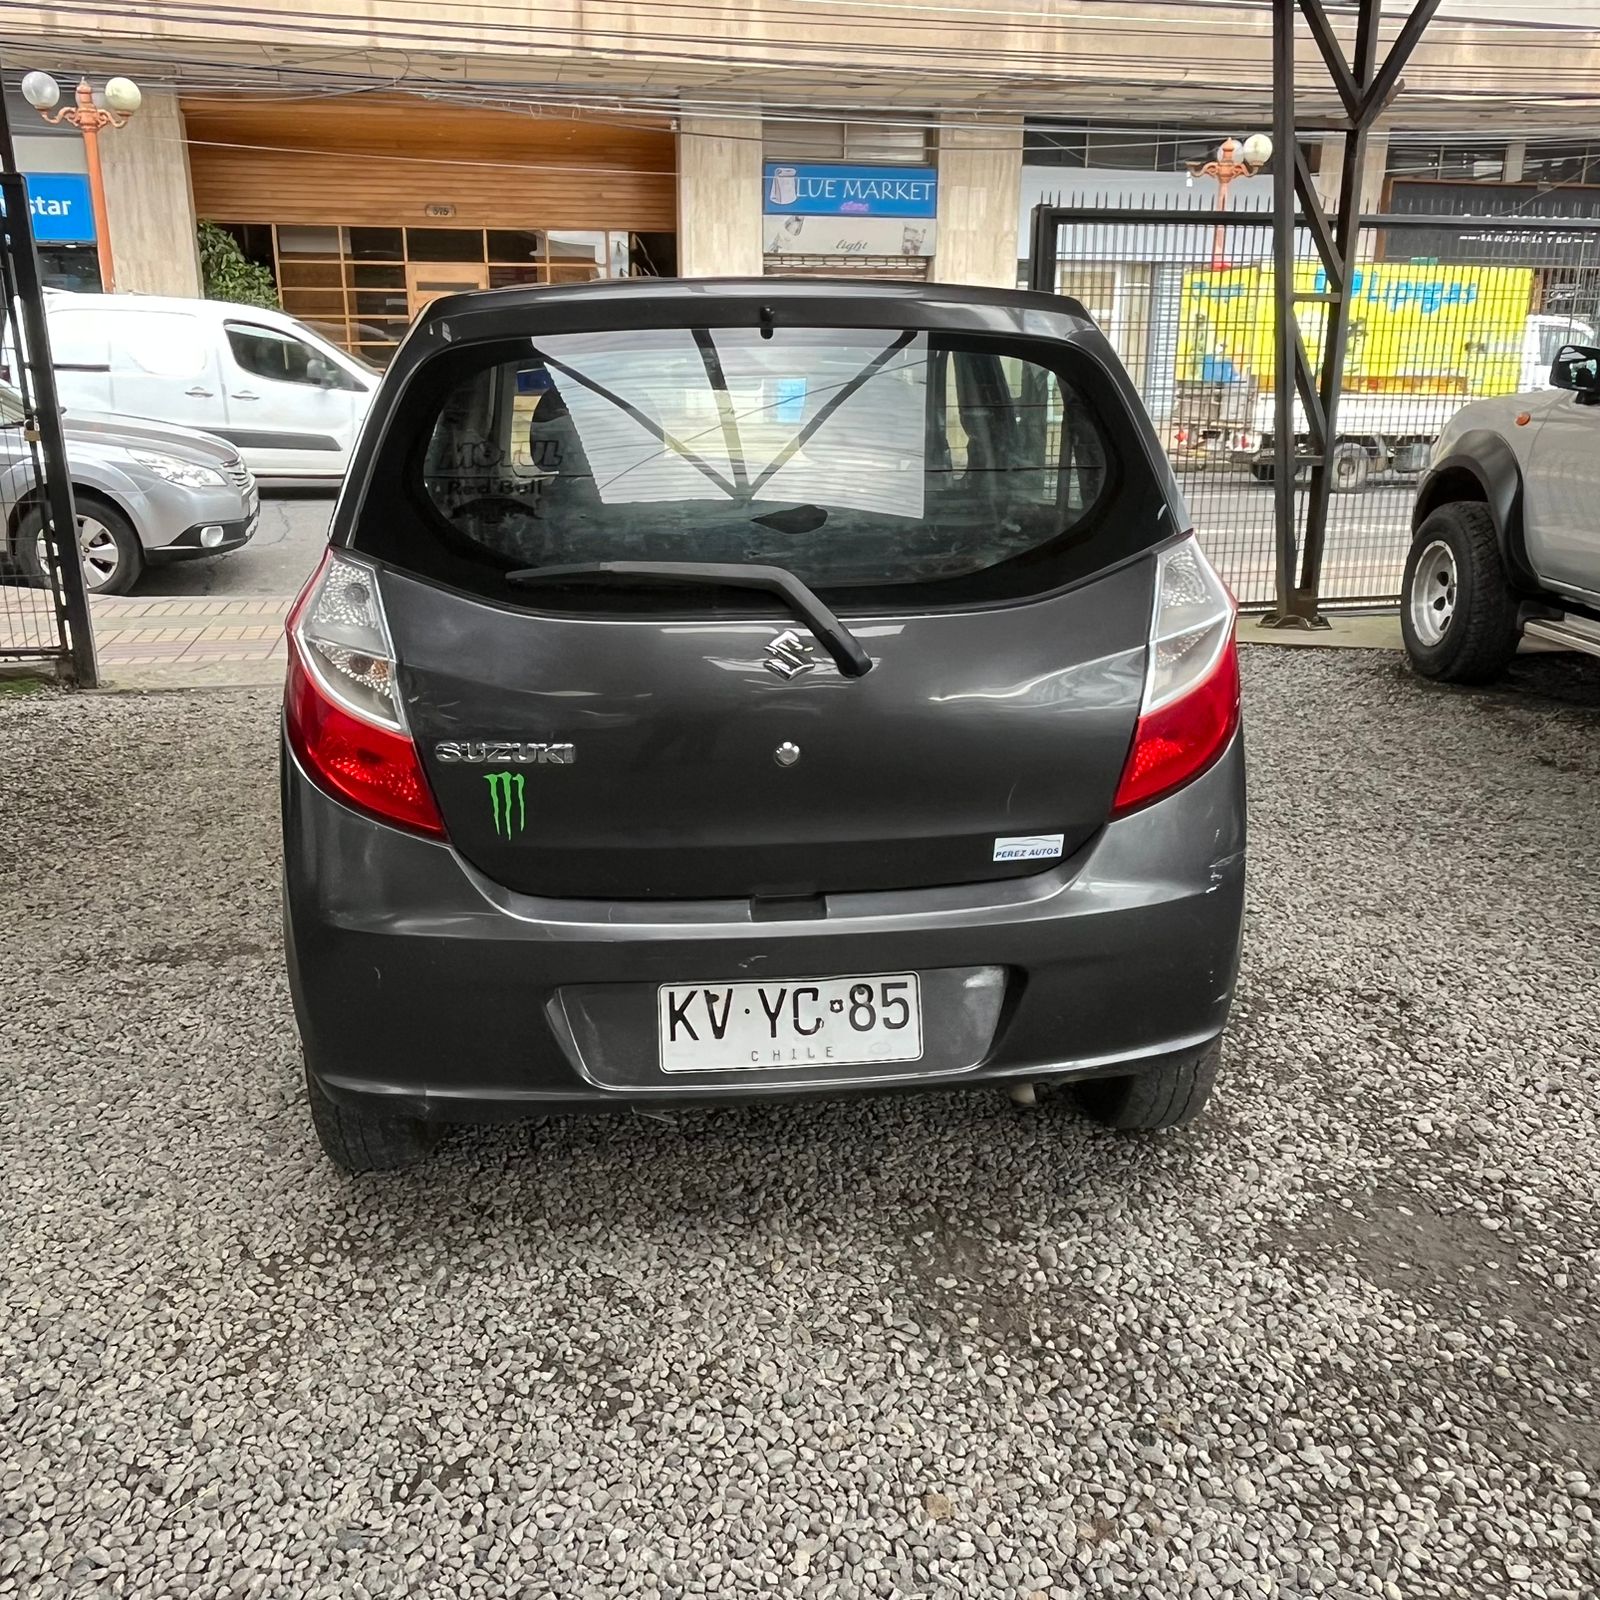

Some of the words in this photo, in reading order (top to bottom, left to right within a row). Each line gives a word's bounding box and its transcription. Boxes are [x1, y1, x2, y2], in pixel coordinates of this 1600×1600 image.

[843, 180, 936, 200] MARKET
[28, 195, 72, 216] star
[435, 742, 576, 764] SUZUKI
[995, 848, 1027, 859] PEREZ
[1028, 847, 1059, 857] AUTOS
[750, 1046, 835, 1063] CHILE
